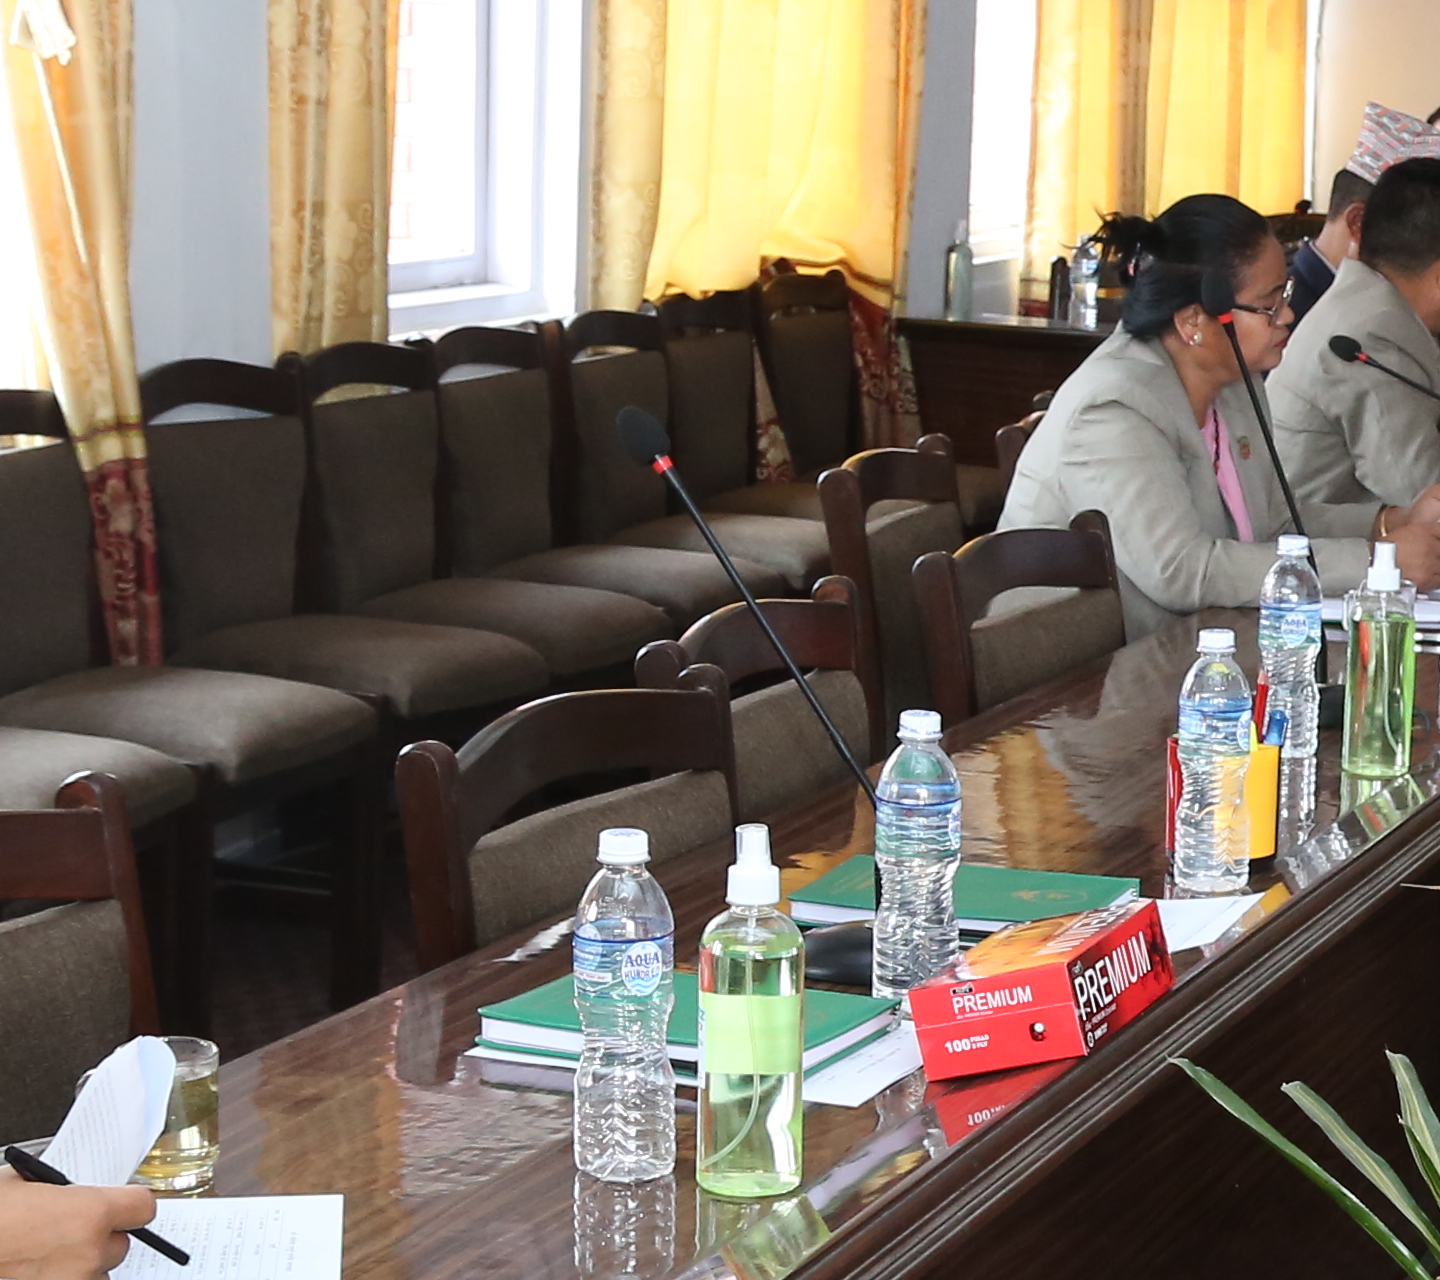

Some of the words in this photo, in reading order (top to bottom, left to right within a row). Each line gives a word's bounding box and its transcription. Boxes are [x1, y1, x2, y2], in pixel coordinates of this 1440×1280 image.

[624, 952, 660, 968] AQUA
[1073, 930, 1153, 1020] PREMIUM
[952, 985, 1033, 1015] PREMIUM
[944, 1038, 972, 1054] 100
